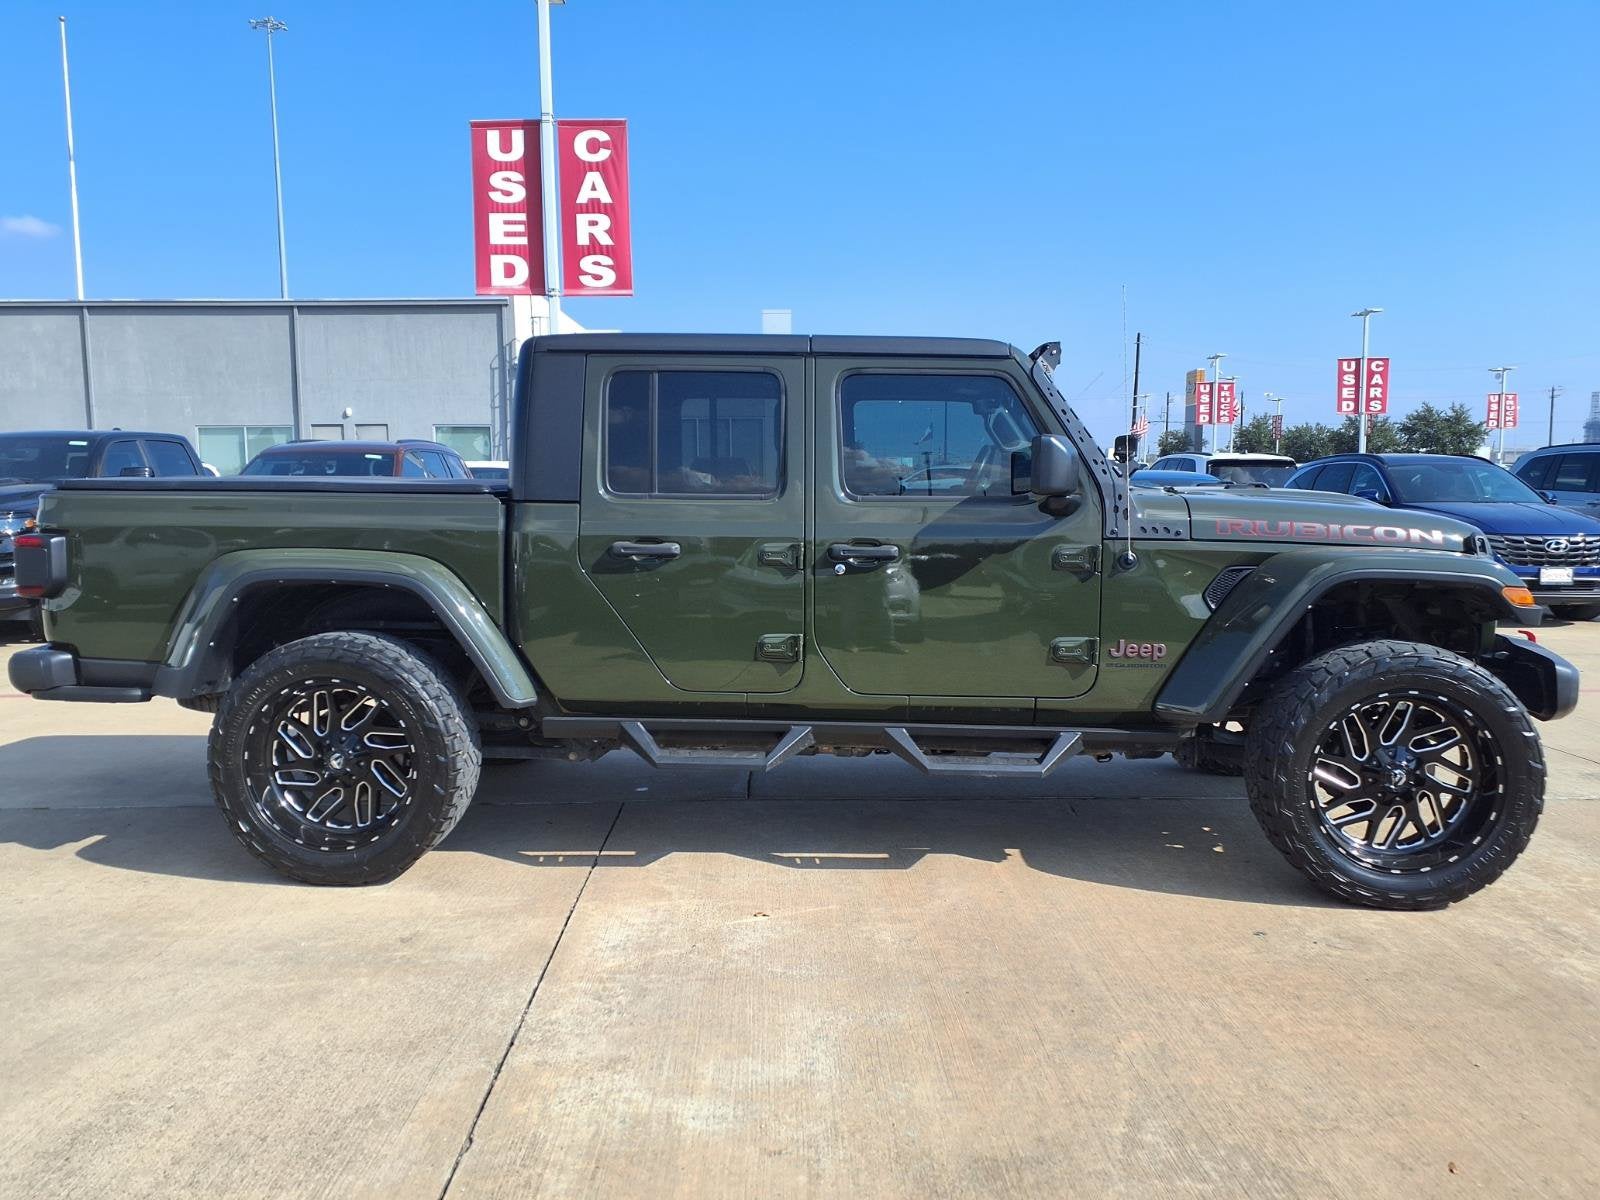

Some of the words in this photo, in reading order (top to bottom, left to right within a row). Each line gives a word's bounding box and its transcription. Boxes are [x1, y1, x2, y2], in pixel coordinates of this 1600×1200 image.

[486, 129, 530, 287] USED
[573, 129, 617, 288] CARS
[1199, 384, 1210, 423] USED
[1220, 384, 1231, 423] TRUCKS
[1341, 360, 1356, 412] USED
[1369, 360, 1385, 412] CARS
[1215, 518, 1444, 545] RUBICON
[1109, 639, 1167, 661] Jeep
